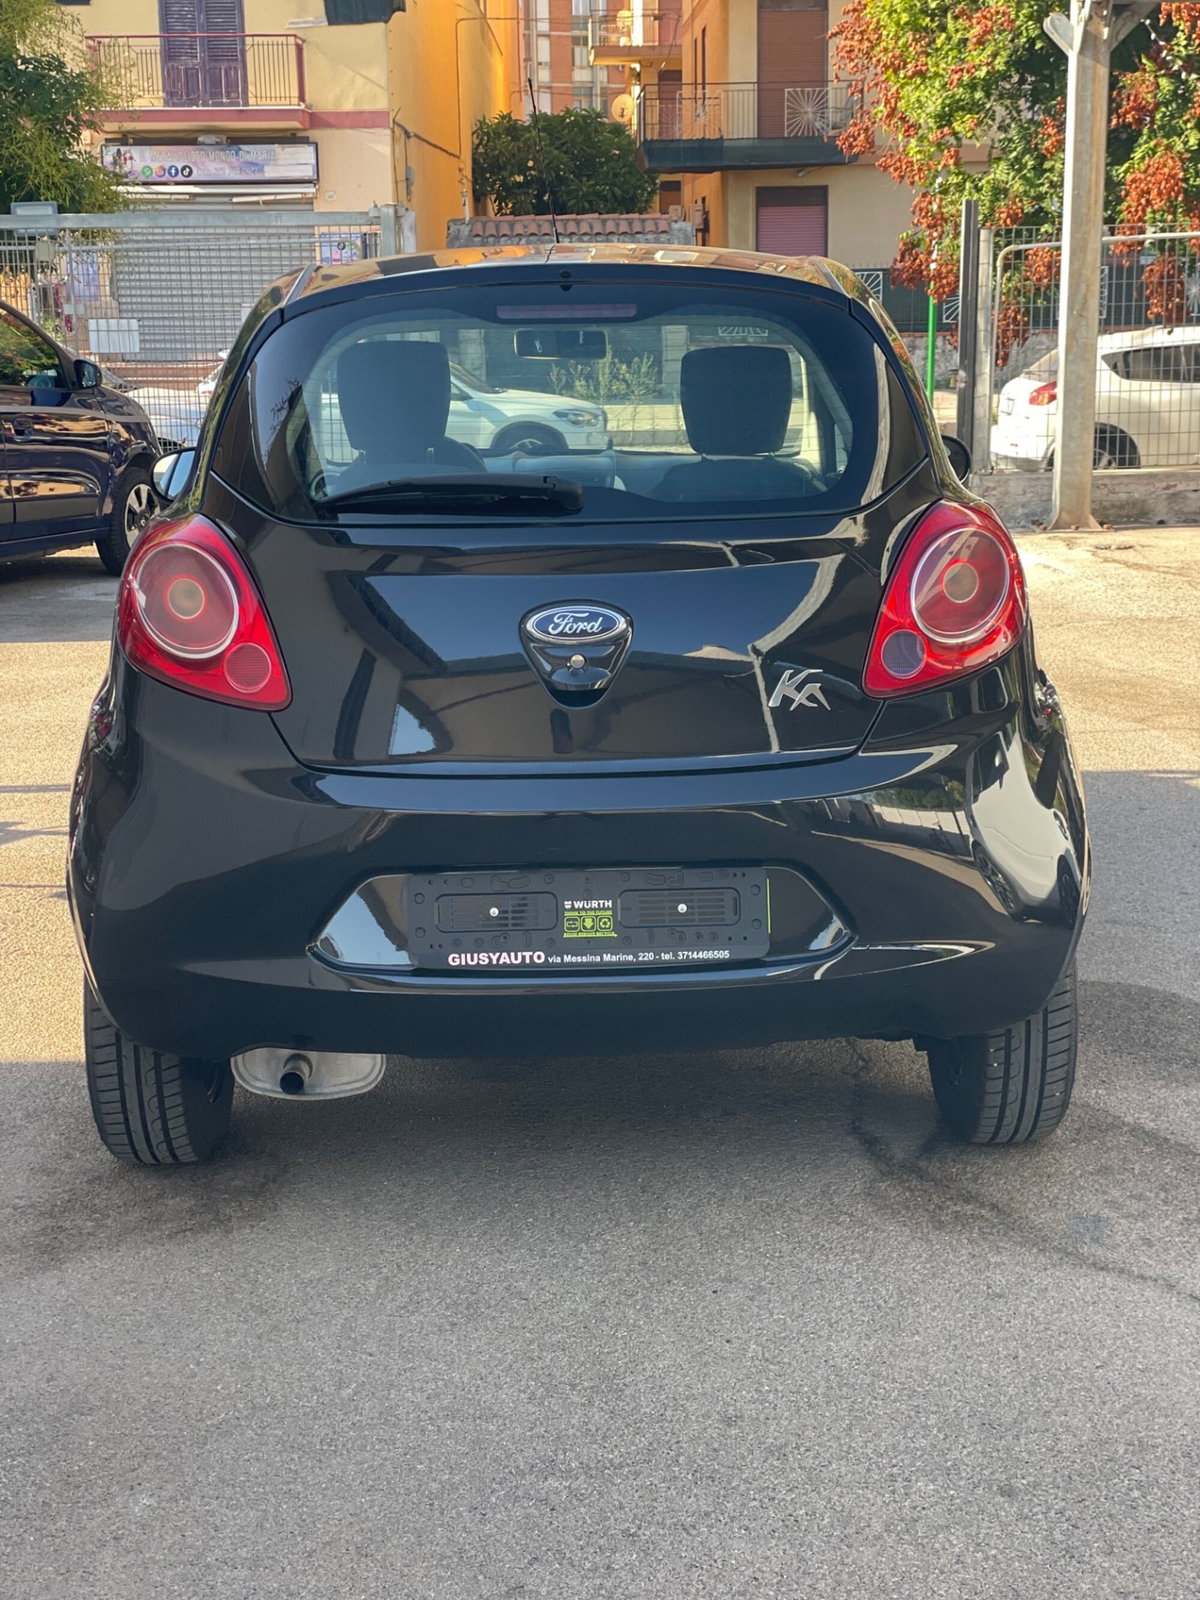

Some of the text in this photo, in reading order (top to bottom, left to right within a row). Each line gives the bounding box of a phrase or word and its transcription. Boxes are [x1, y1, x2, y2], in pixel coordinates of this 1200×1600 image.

[548, 612, 604, 635] Ford
[447, 951, 546, 966] GIUSYAUTO
[548, 954, 561, 963] via
[563, 953, 601, 963] Messina
[603, 952, 636, 963] Marine,
[638, 952, 654, 961] 220
[661, 951, 676, 960] tel.
[677, 950, 730, 960] 3714466505
